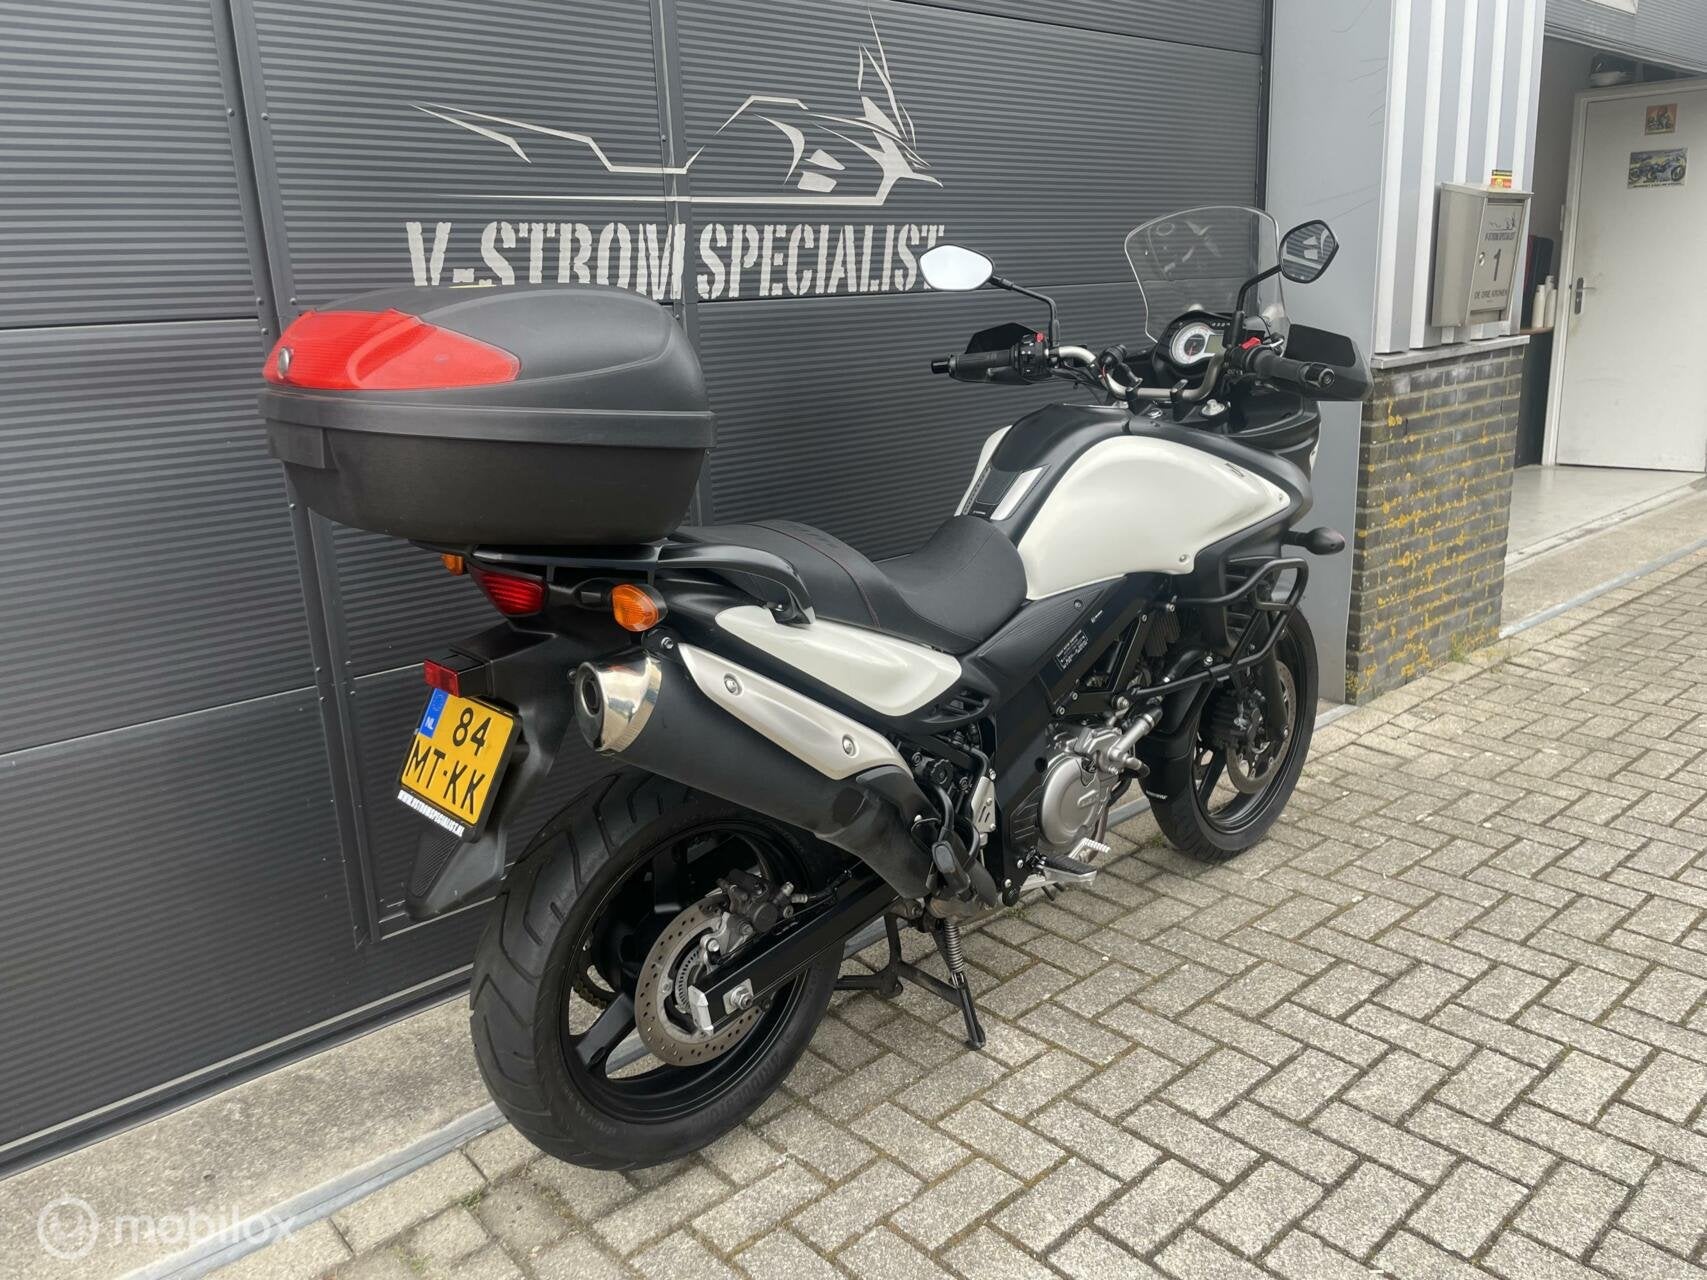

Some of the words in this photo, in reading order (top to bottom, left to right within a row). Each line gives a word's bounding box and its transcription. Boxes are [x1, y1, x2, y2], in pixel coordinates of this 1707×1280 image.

[405, 221, 686, 300] V-STROM
[697, 223, 945, 299] SPECIALIST
[1493, 248, 1502, 281] 1
[425, 717, 435, 730] NL
[452, 707, 492, 756] 84
